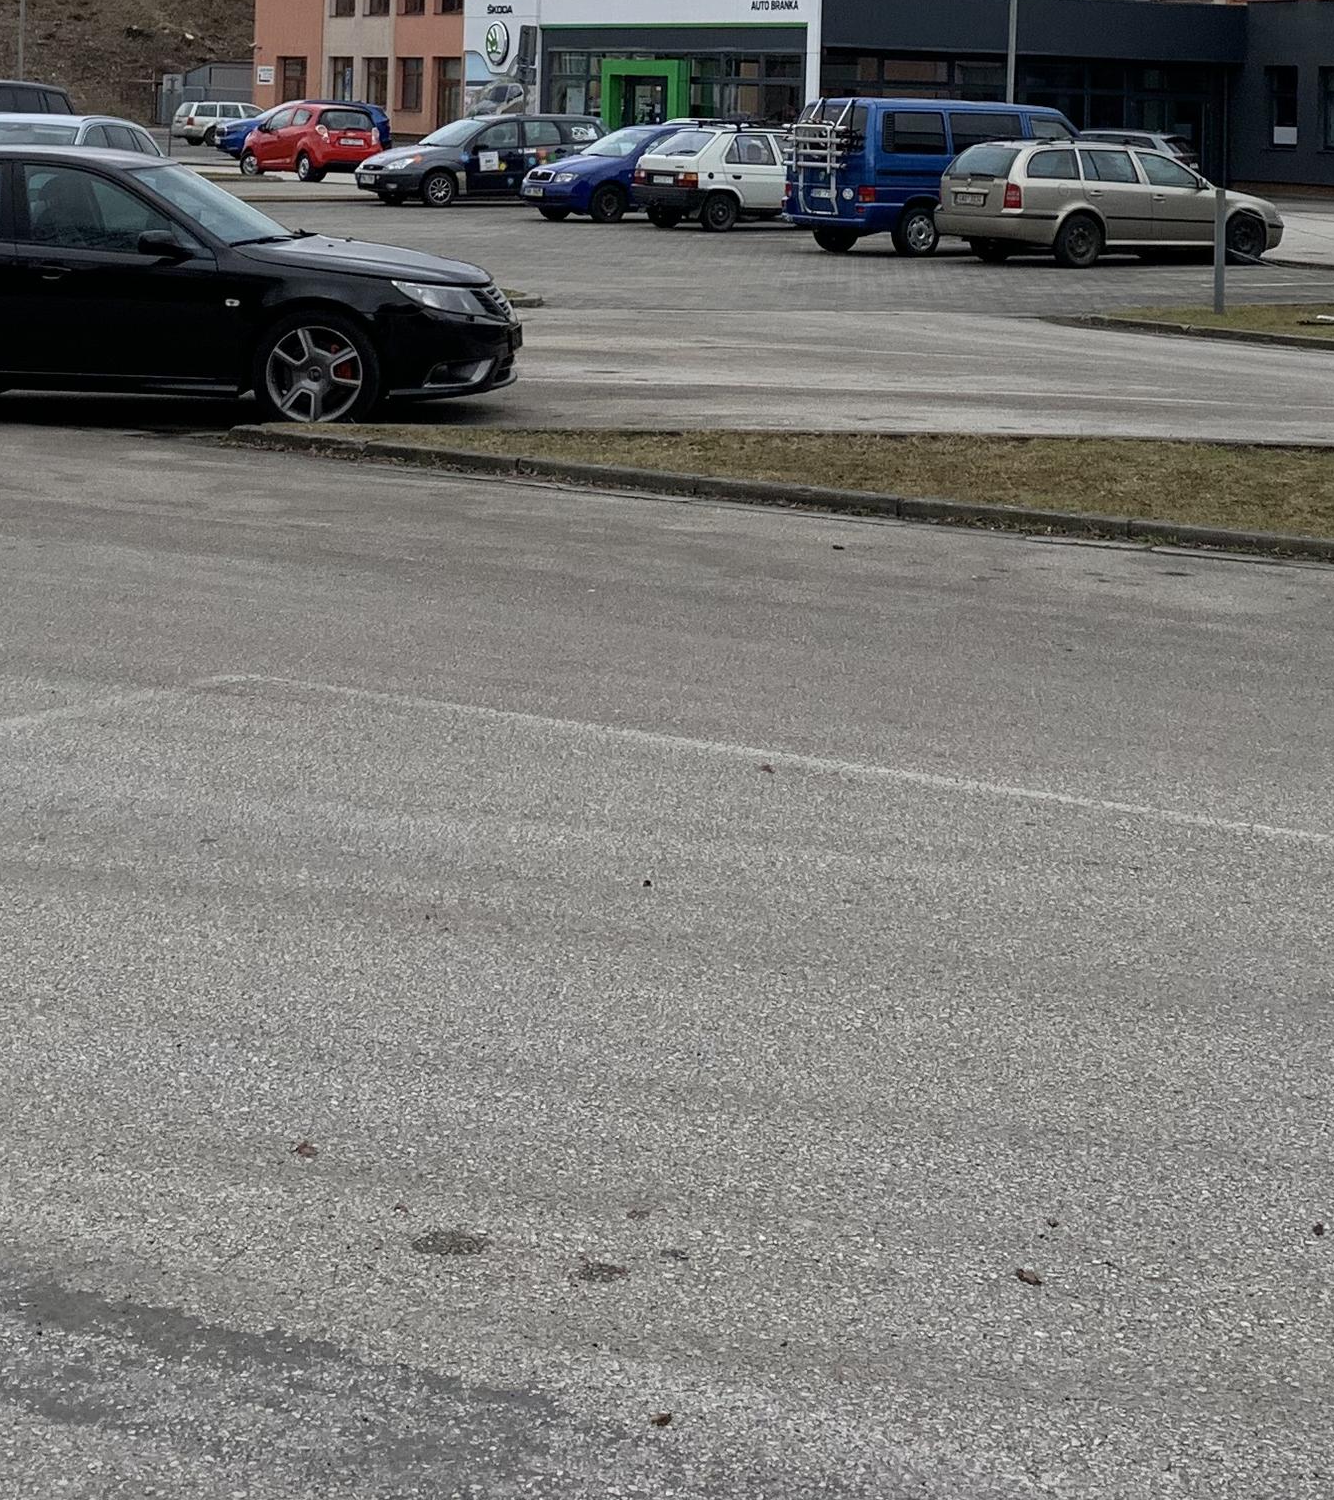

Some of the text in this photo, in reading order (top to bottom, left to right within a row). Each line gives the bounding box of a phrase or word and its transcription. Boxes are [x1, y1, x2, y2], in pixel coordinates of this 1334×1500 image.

[487, 4, 513, 14] ŠKODA
[751, 0, 799, 11] AUTO BRANKA
